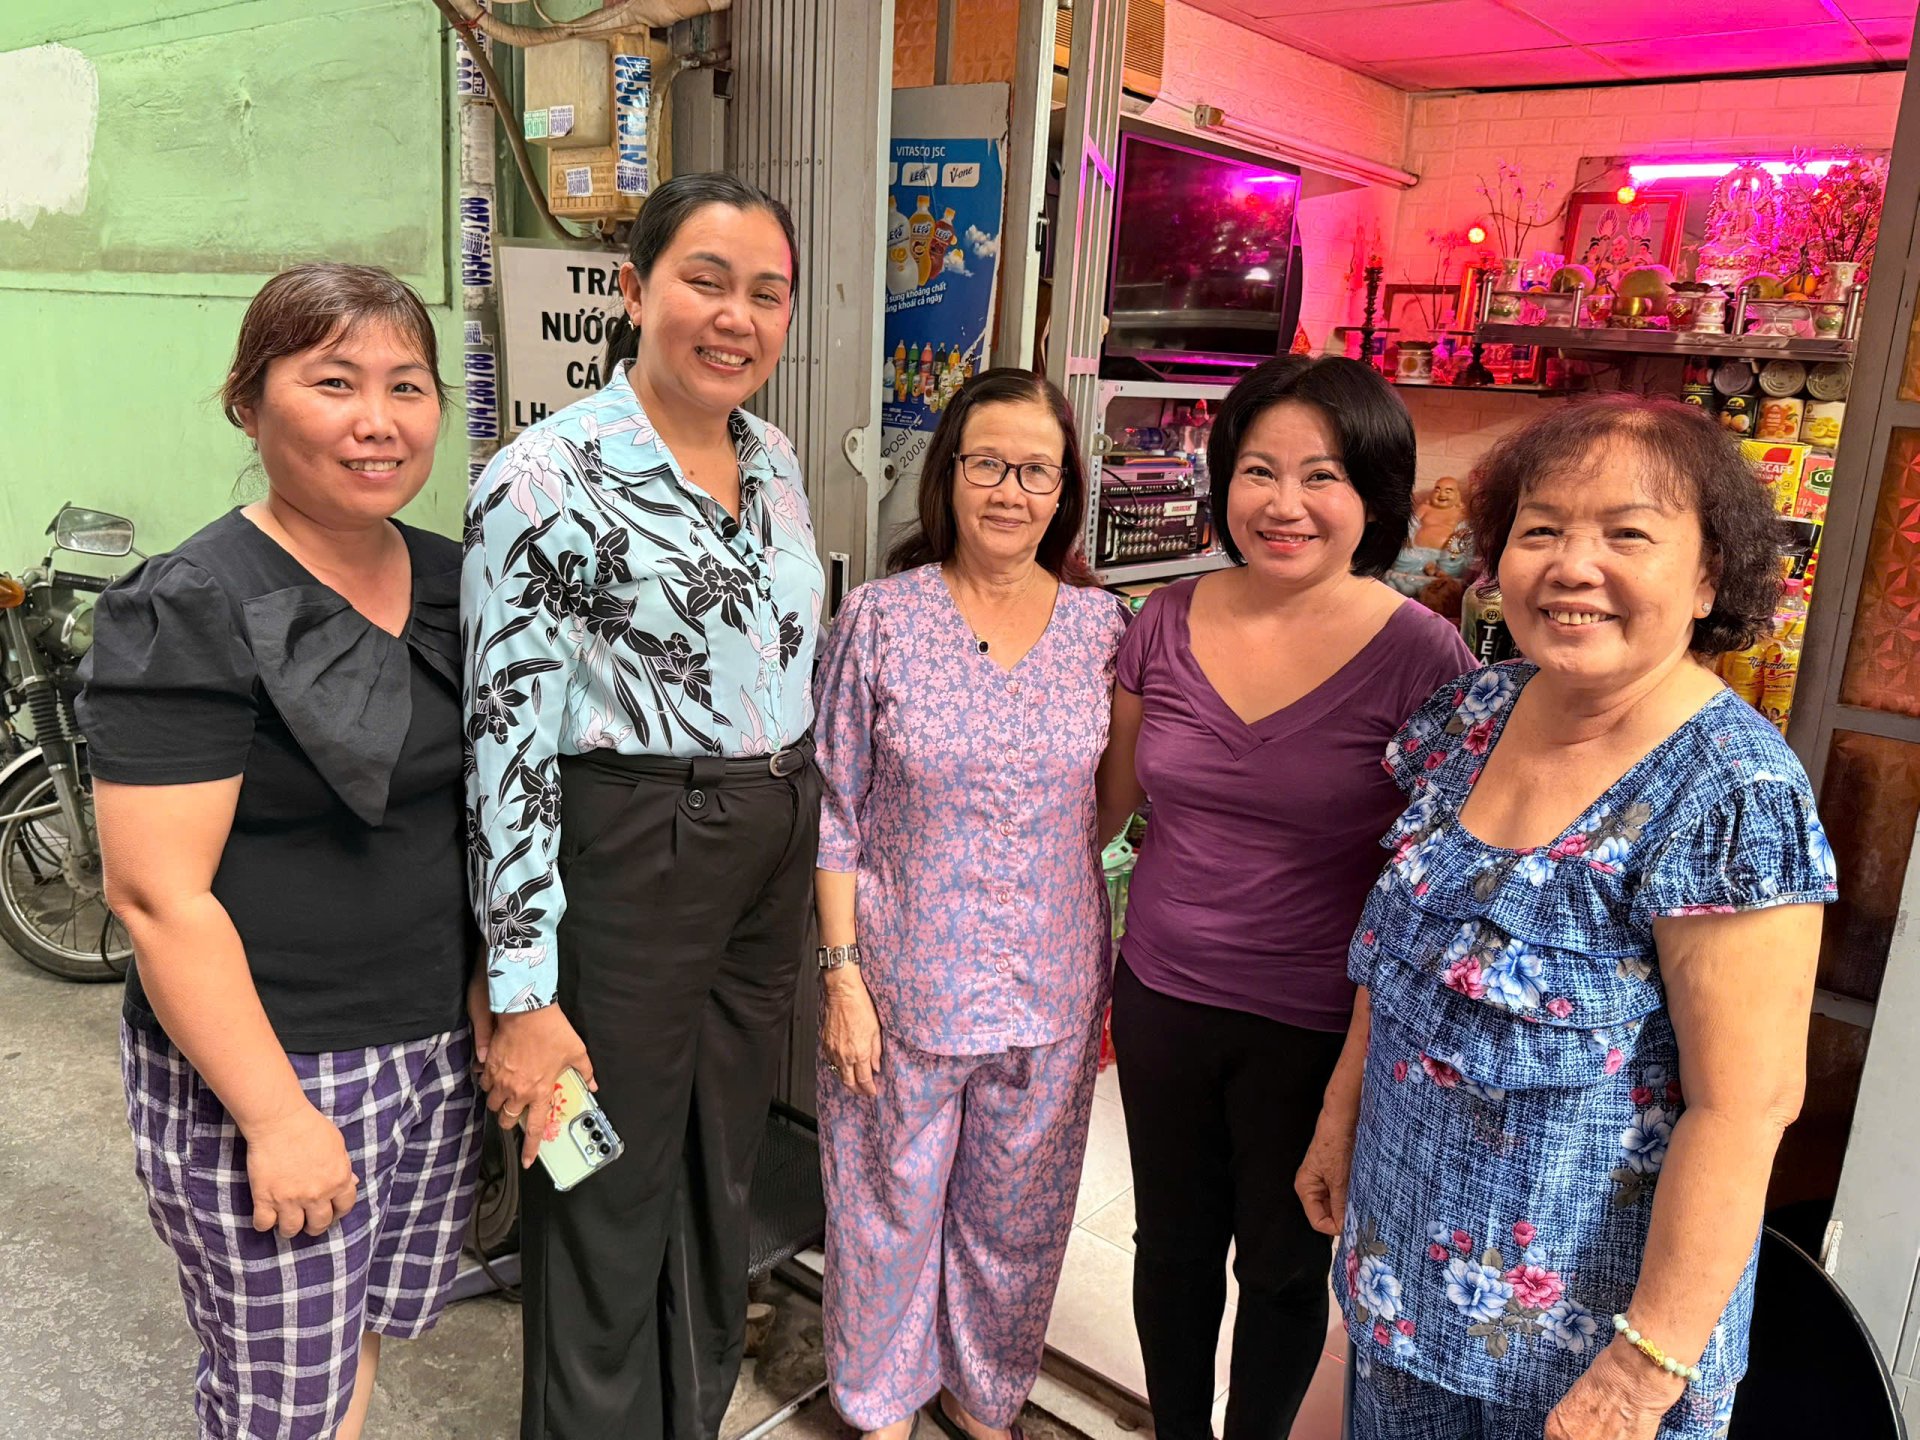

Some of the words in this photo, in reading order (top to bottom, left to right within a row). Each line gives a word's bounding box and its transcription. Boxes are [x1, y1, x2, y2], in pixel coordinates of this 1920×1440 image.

[896, 146, 929, 157] VITASCO
[931, 146, 946, 158] JSC
[900, 437, 926, 468] 2008
